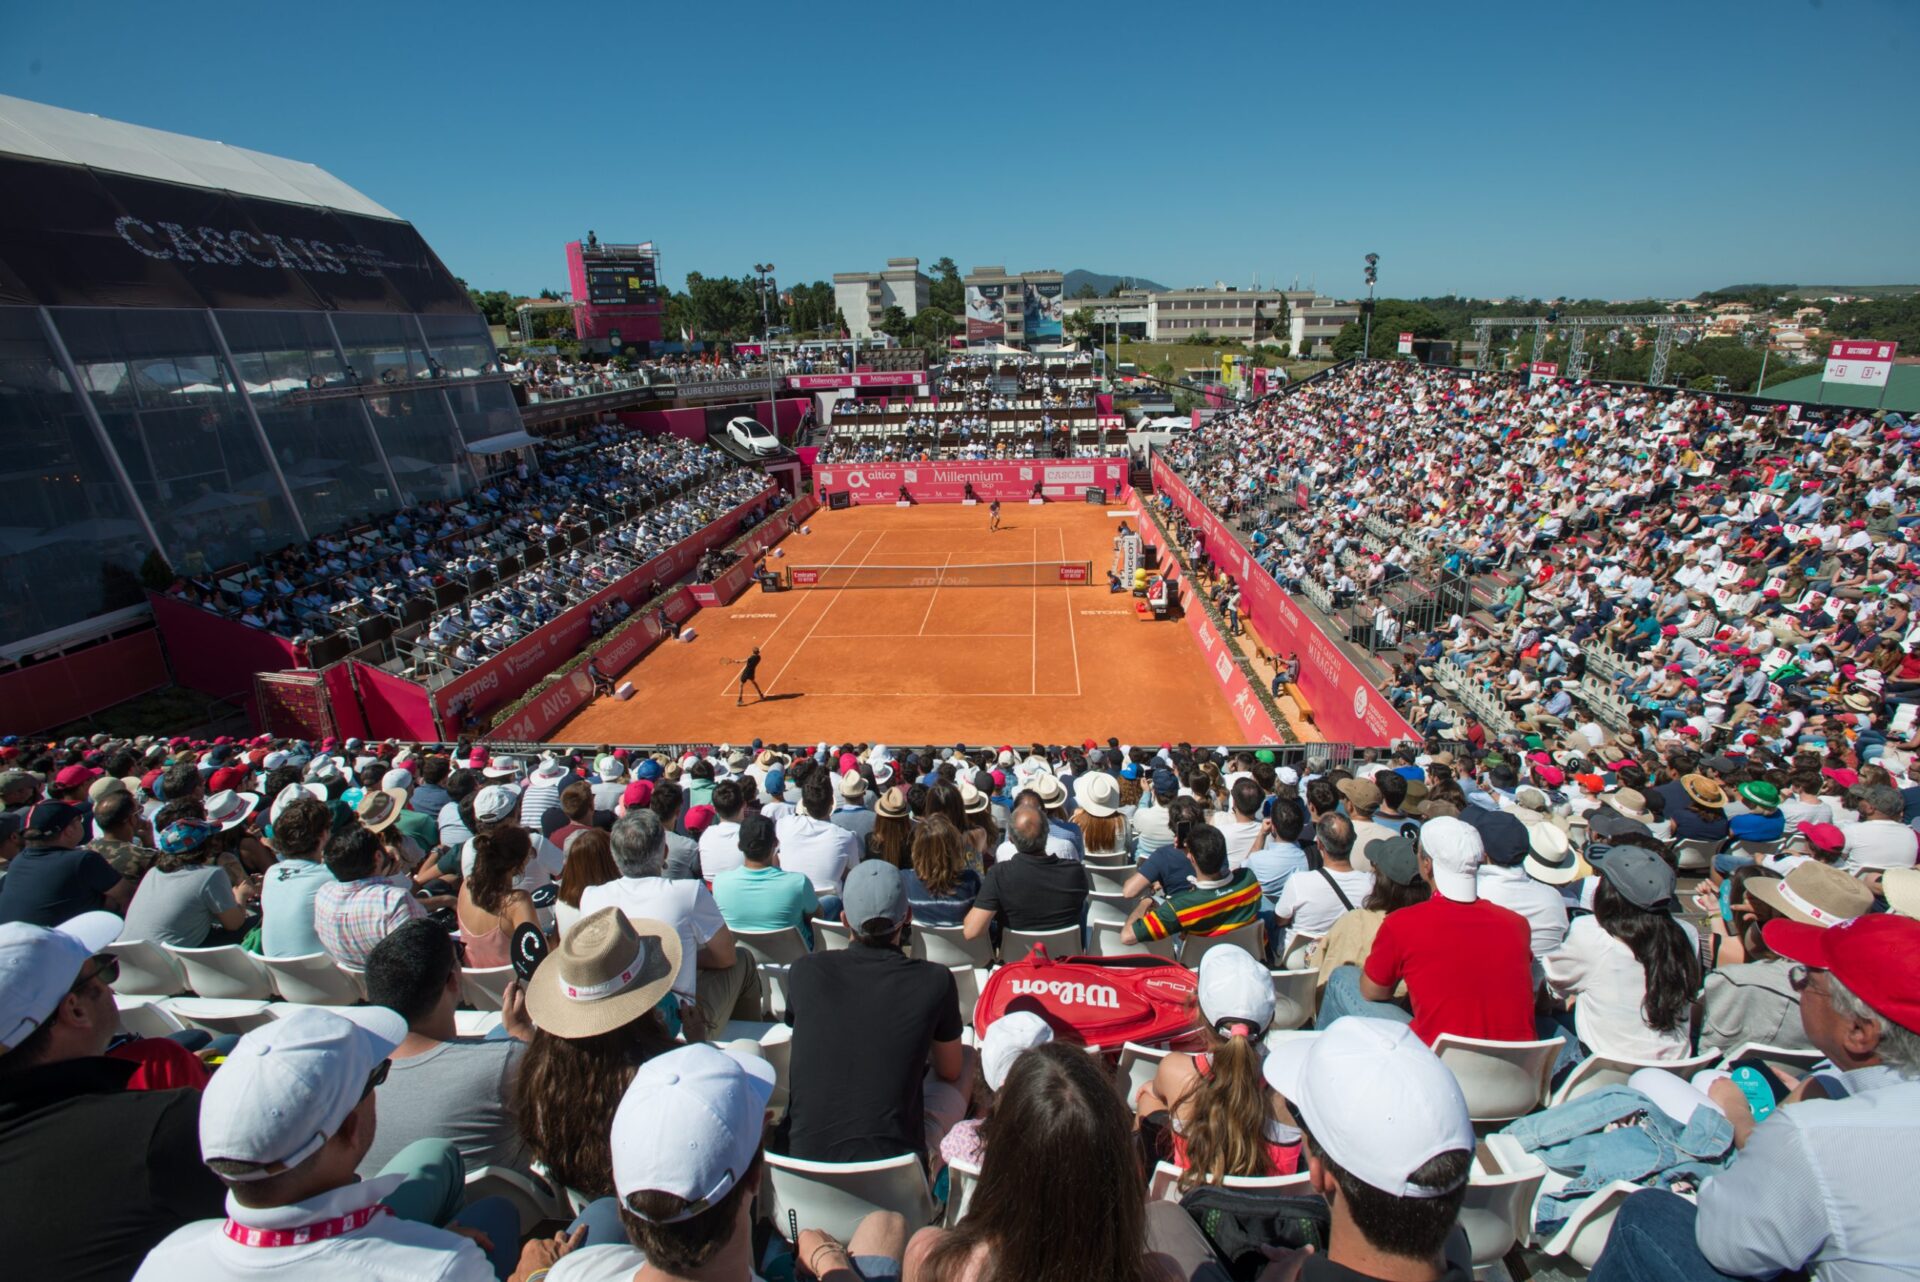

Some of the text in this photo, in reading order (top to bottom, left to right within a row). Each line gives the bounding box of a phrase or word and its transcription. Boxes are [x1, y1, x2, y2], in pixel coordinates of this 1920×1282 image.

[114, 215, 348, 275] CASCAIS
[809, 376, 843, 384] Millennium
[870, 375, 903, 383] Millennium
[678, 385, 702, 397] CLUBE
[704, 385, 715, 394] DE
[738, 382, 750, 391] DO
[750, 380, 780, 391] ESTOIL
[867, 470, 897, 481] altice
[934, 468, 1003, 483] Millennium
[1047, 470, 1092, 480] CASCAIS
[981, 482, 994, 490] bcp
[910, 577, 936, 587] ATP
[1307, 642, 1340, 688] MIRAGEM
[464, 669, 499, 703] smeg
[541, 687, 571, 722] AVIS
[1243, 703, 1256, 725] ctt
[1011, 979, 1120, 1009] Wilson
